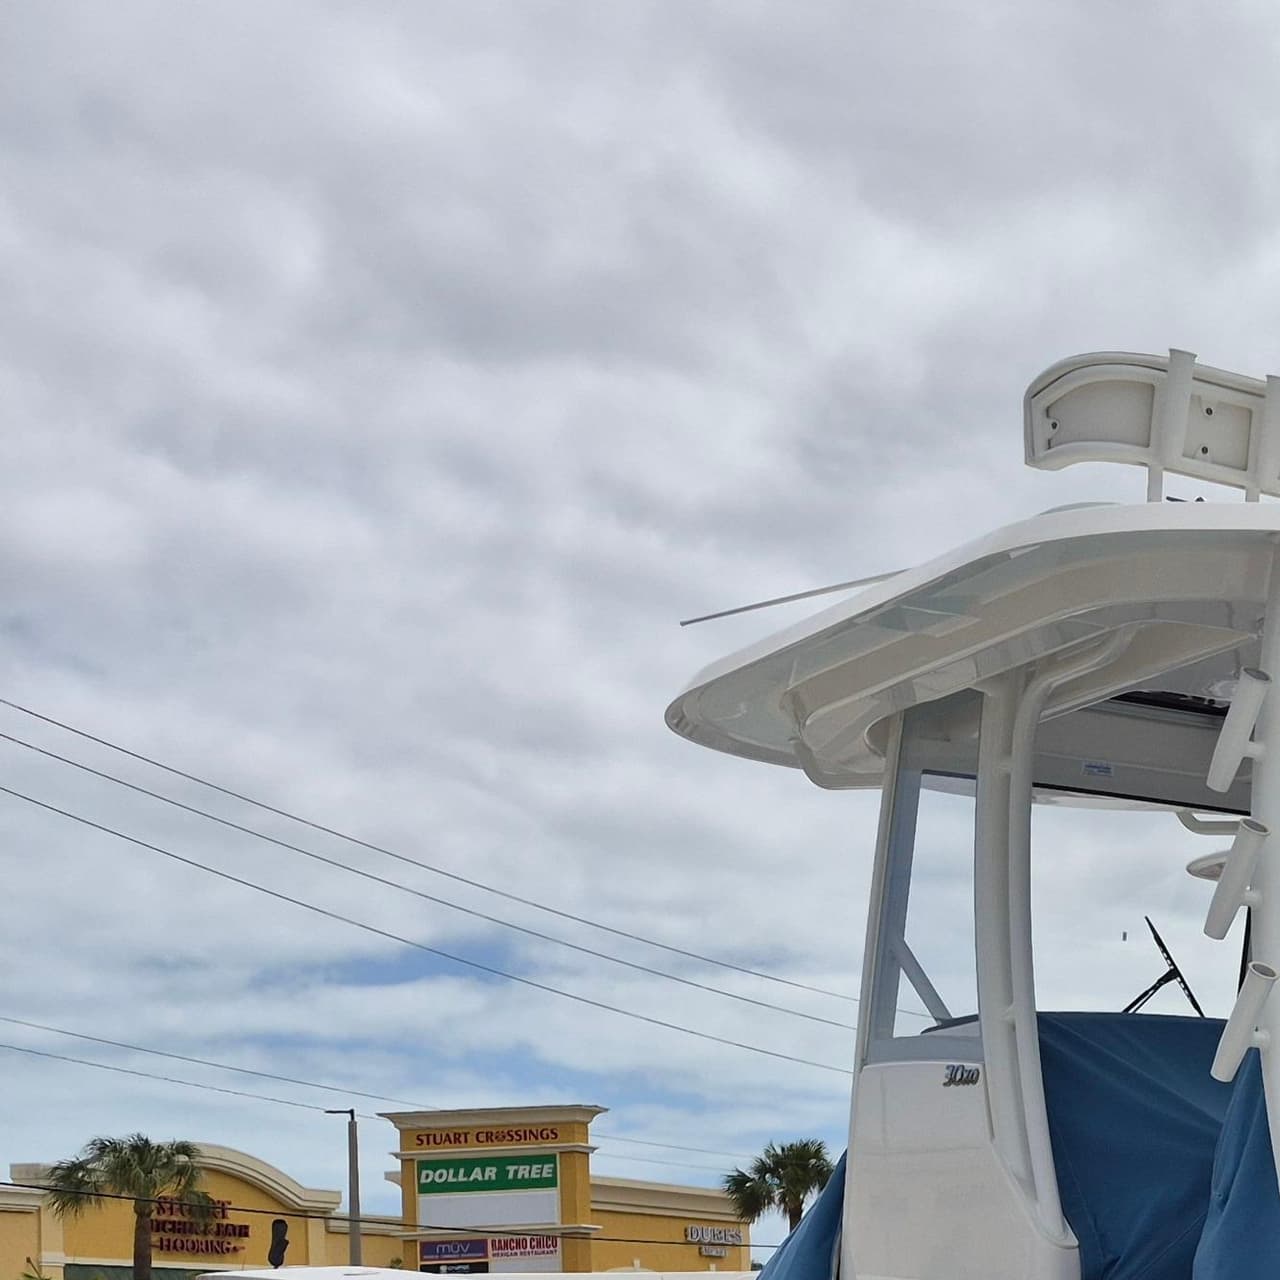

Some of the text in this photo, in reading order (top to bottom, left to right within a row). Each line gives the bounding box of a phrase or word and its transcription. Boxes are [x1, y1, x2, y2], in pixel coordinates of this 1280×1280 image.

[415, 1127, 559, 1147] STUART CROSSINGS
[420, 1163, 554, 1184] DOLLAR TREE
[160, 1237, 232, 1255] FLOORING
[490, 1235, 558, 1251] RANCHO CHICO
